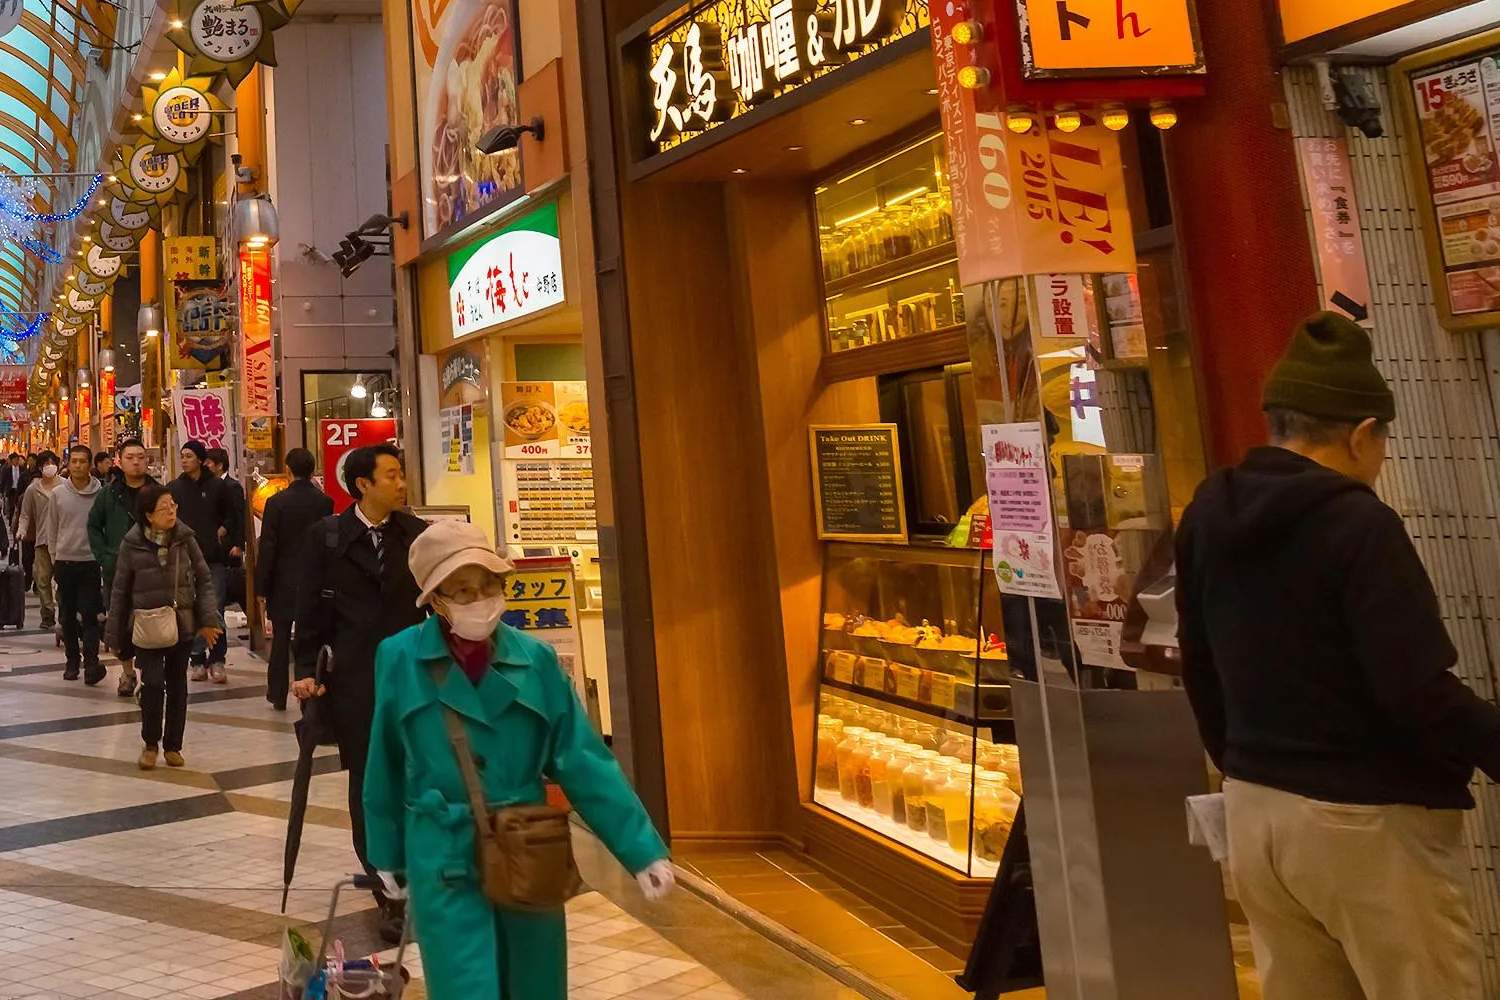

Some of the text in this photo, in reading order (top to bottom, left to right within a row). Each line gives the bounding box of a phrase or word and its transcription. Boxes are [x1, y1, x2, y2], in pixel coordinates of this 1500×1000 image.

[201, 15, 249, 40] 艶まる
[203, 38, 250, 56] サンモール
[650, 21, 717, 142] 天馬
[807, 13, 825, 66] &
[1417, 77, 1445, 113] 15
[975, 112, 1011, 210] 160
[1020, 149, 1054, 221] 2015
[485, 251, 529, 315] 梅もと
[256, 298, 270, 326] 160
[1050, 273, 1076, 336] ラ設置
[326, 423, 358, 446] 2F
[521, 445, 548, 455] 400円
[576, 445, 592, 455] 37
